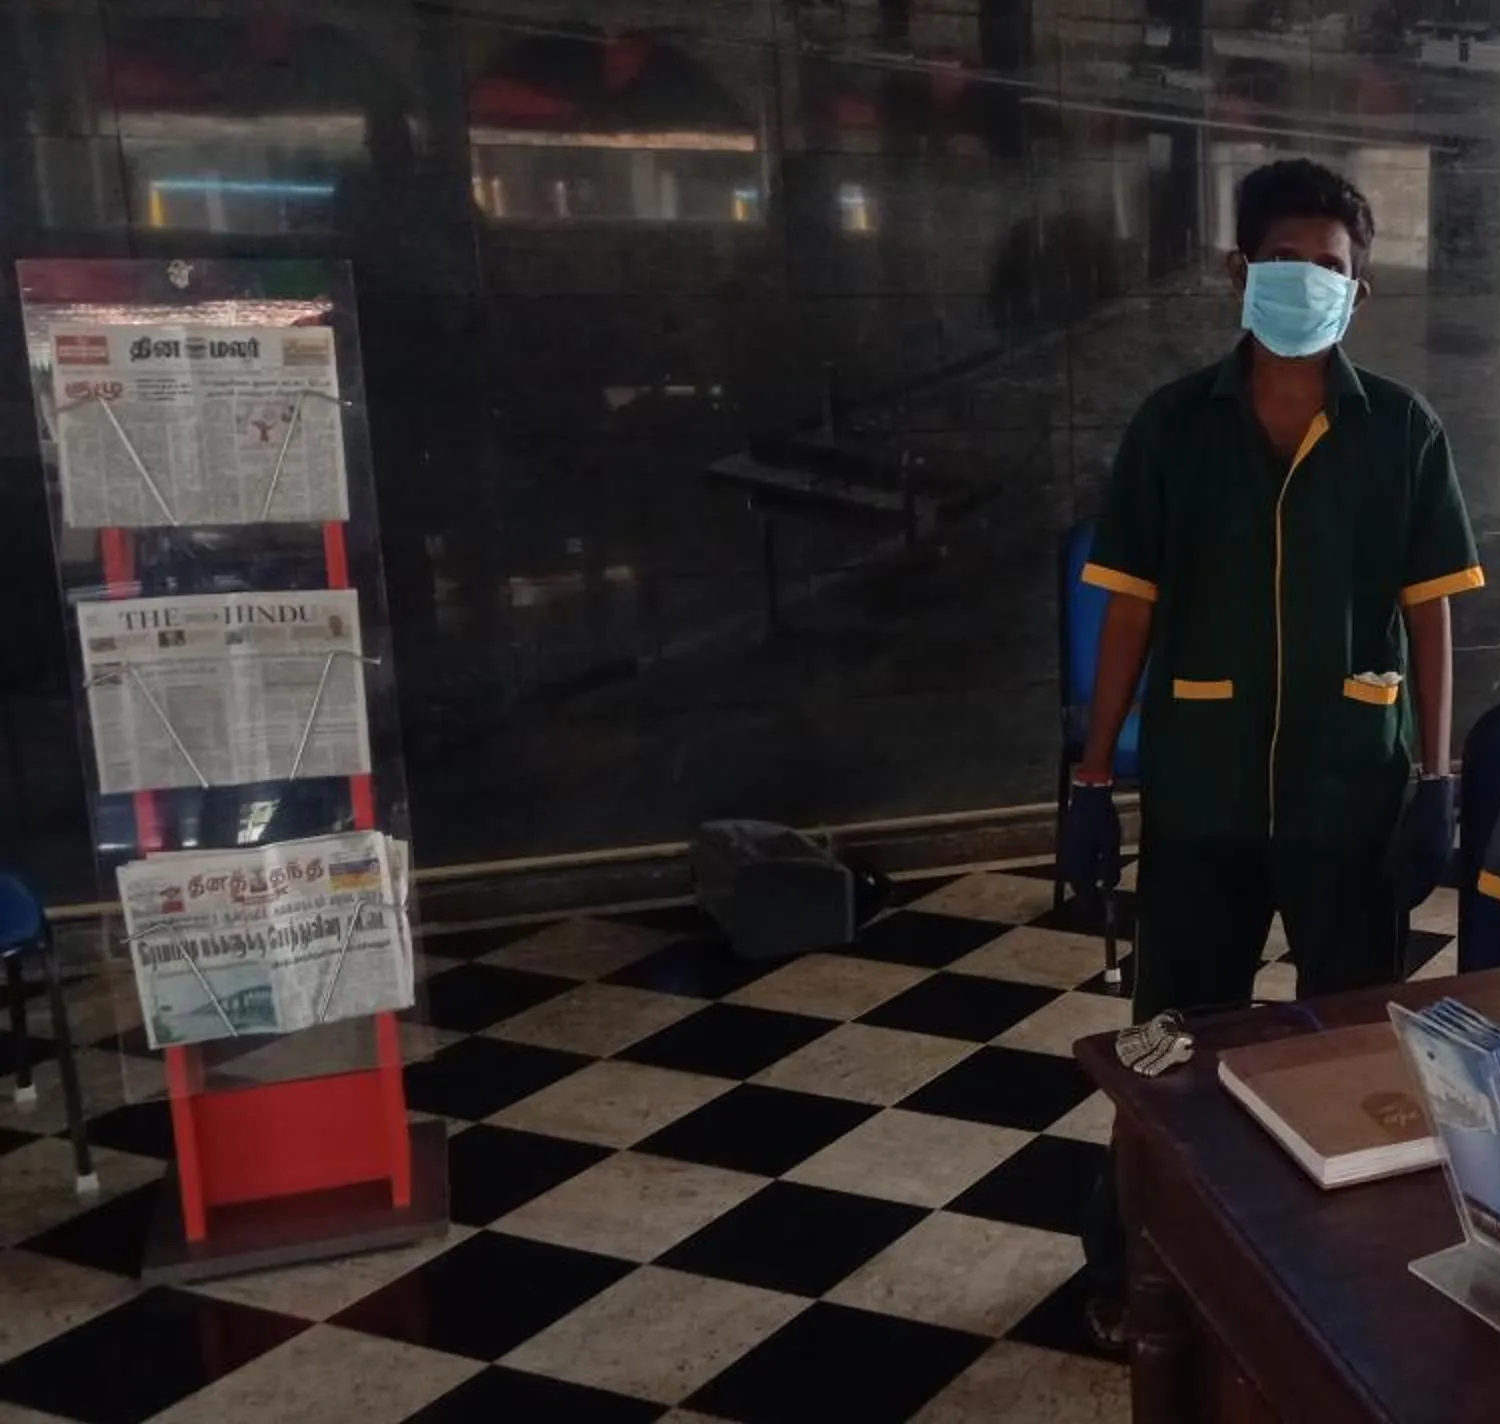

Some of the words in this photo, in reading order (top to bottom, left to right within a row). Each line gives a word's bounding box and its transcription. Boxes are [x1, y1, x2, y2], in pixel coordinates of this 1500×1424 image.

[129, 334, 181, 362] தின
[209, 334, 262, 360] மலர்
[119, 607, 181, 631] THE
[223, 604, 318, 626] HINDU
